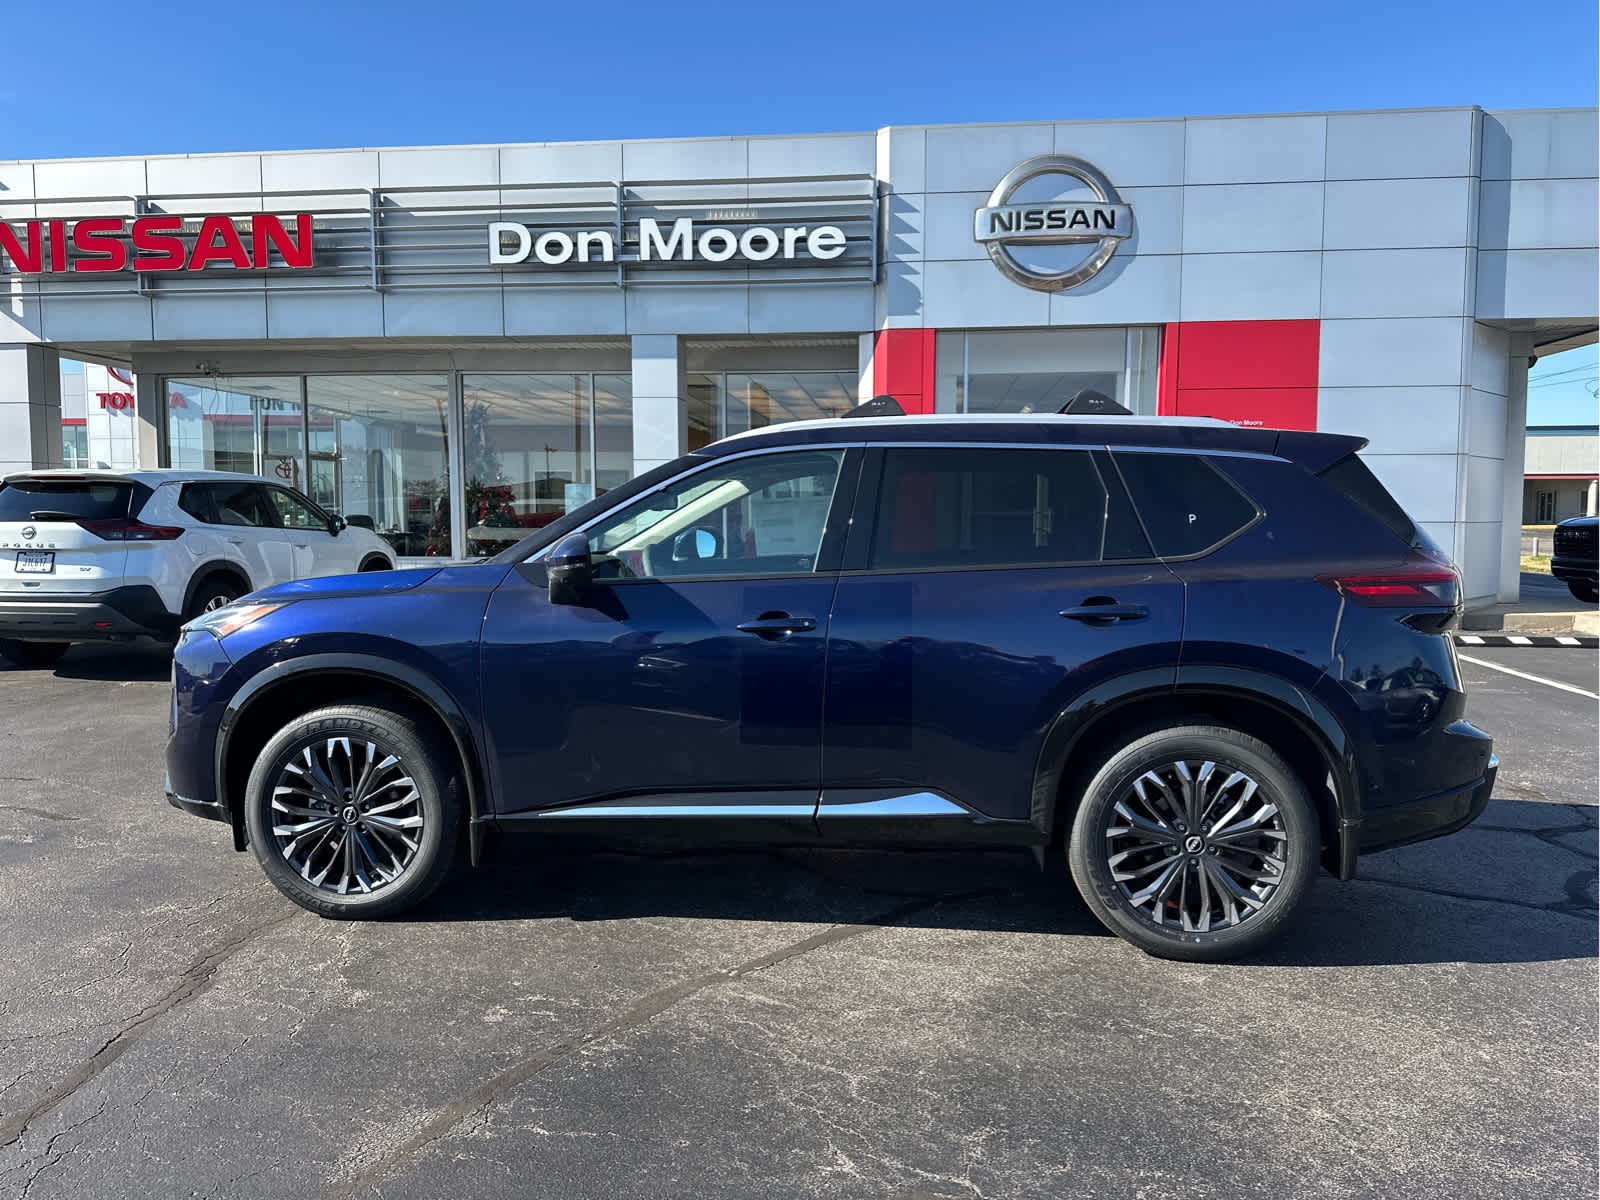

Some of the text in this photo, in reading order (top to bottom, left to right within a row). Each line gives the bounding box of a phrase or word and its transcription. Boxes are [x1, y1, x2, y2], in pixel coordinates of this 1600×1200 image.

[990, 209, 1116, 234] NISSAN
[488, 217, 848, 265] Don Moore
[96, 392, 187, 409] TOYA
[1188, 513, 1197, 524] P
